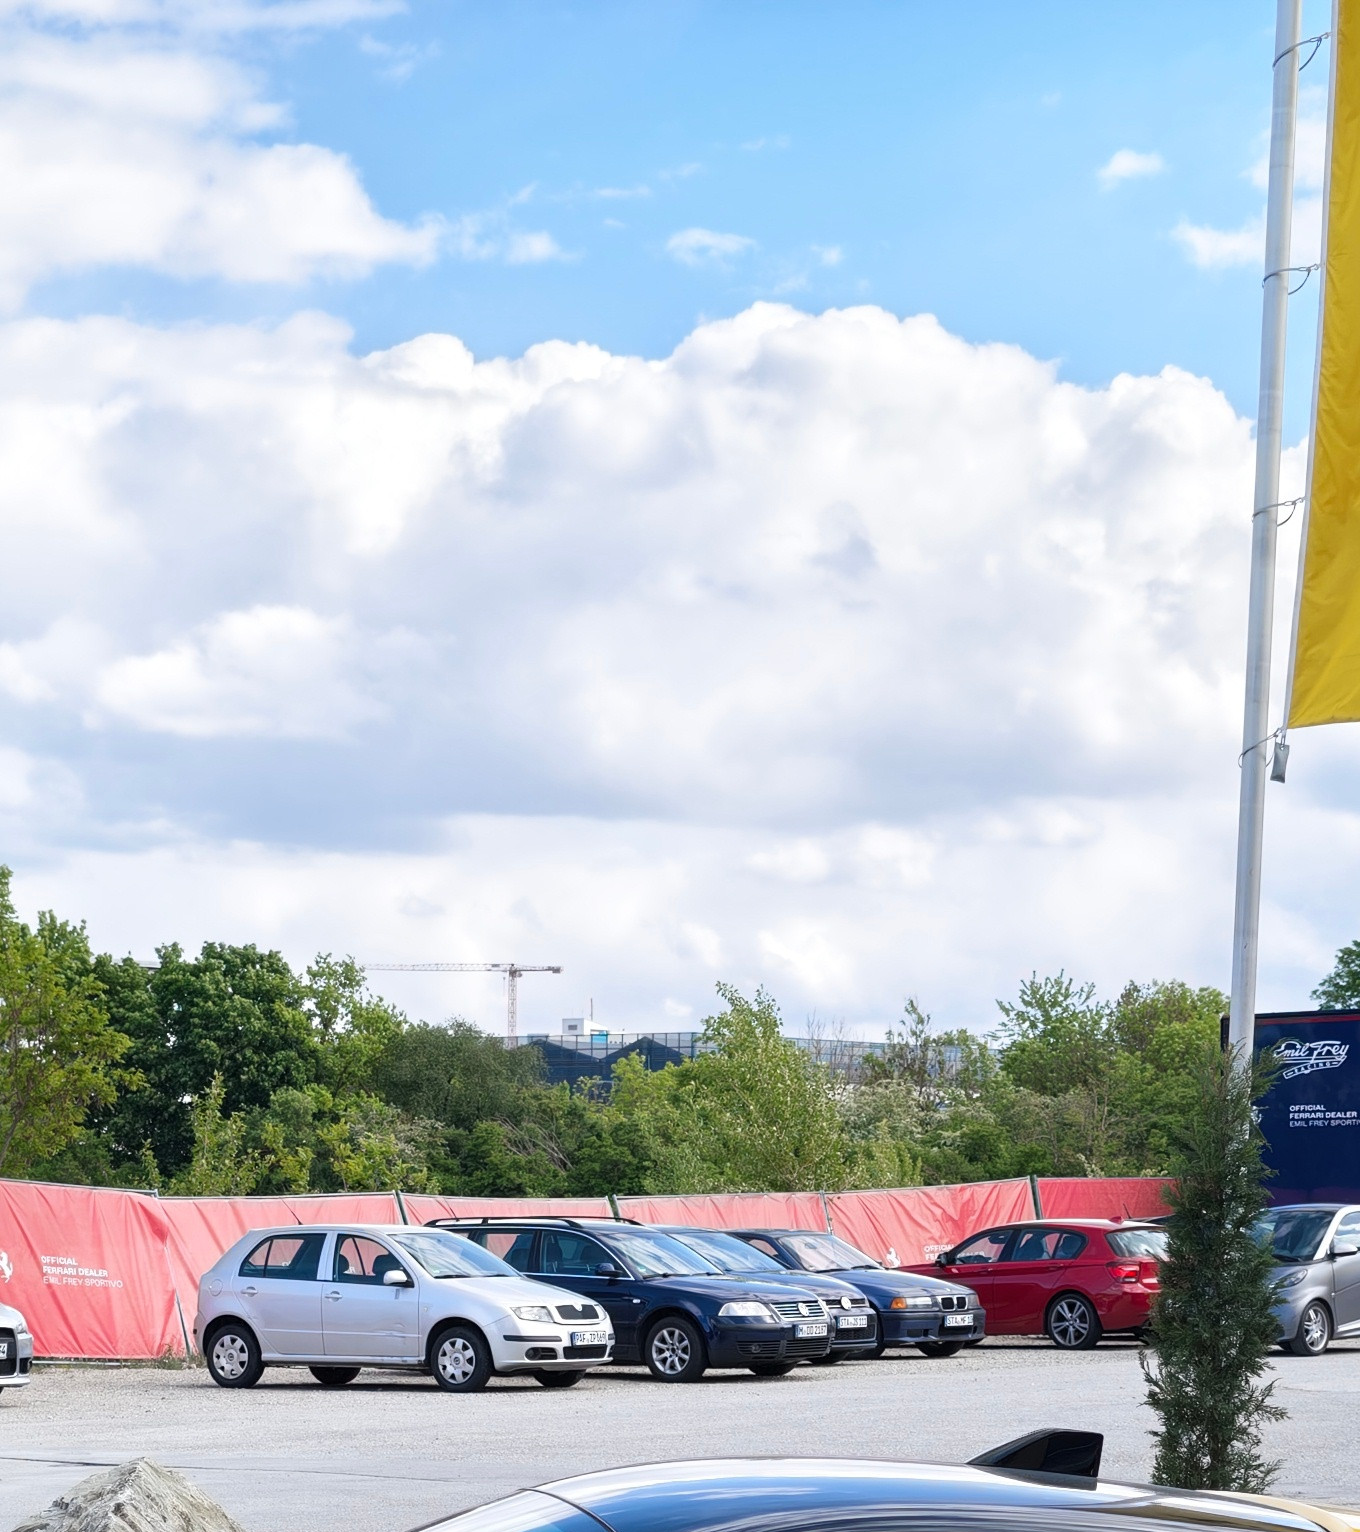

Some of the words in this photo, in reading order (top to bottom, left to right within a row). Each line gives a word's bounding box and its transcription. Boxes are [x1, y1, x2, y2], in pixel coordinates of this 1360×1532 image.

[1309, 1040, 1350, 1064] Frey
[1292, 1060, 1332, 1075] RACING
[1289, 1104, 1326, 1112] OFFICIAL
[1289, 1112, 1324, 1120] FERRARI
[1325, 1111, 1358, 1119] DEALER
[1289, 1119, 1308, 1128] EMIL
[1308, 1119, 1329, 1127] FREY
[41, 1255, 78, 1265] OFFICIAL
[42, 1266, 77, 1275] FERRARI
[78, 1268, 108, 1277] DEALER
[43, 1276, 61, 1285] EMIL
[62, 1277, 83, 1286] FREY
[84, 1278, 123, 1288] SPORTIVO
